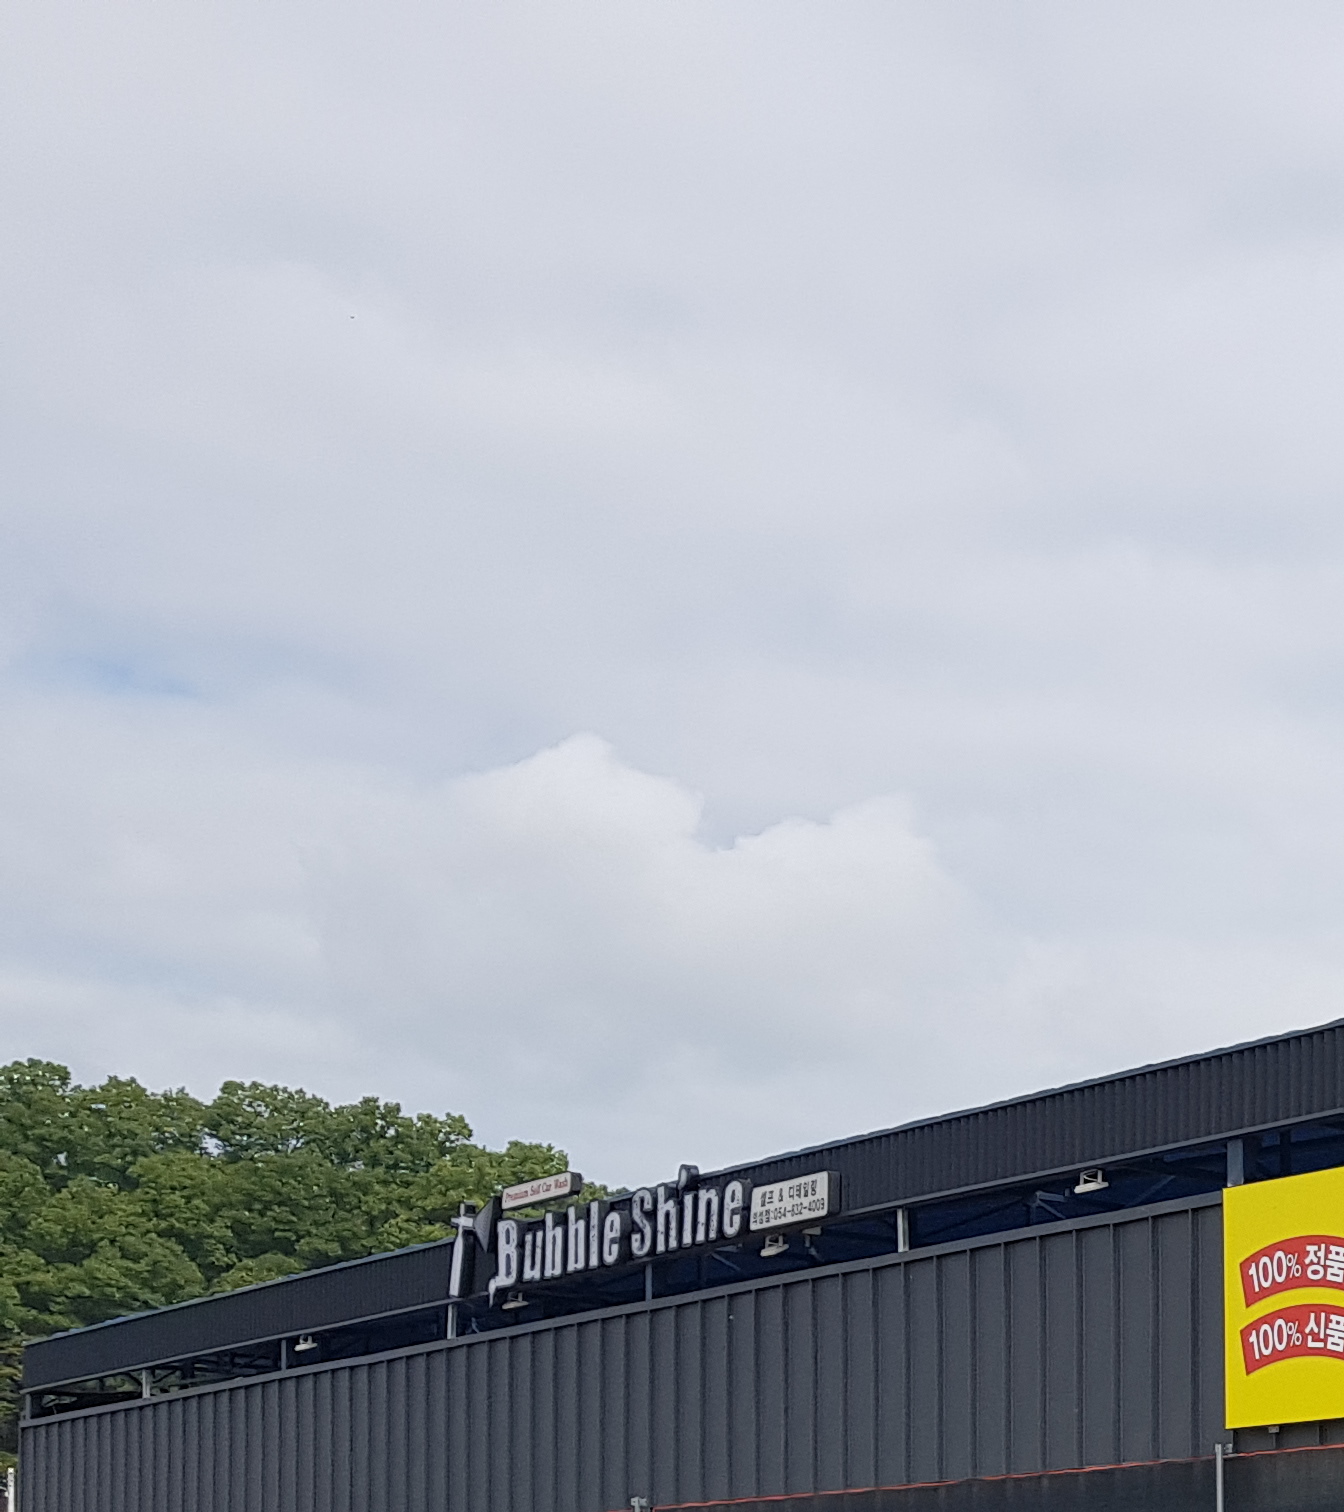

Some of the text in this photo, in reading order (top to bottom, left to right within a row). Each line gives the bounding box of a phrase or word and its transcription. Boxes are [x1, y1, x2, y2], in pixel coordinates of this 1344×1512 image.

[490, 1166, 744, 1290] Bubble Shine
[1248, 1250, 1302, 1293] 100%
[1248, 1317, 1303, 1361] 100%
